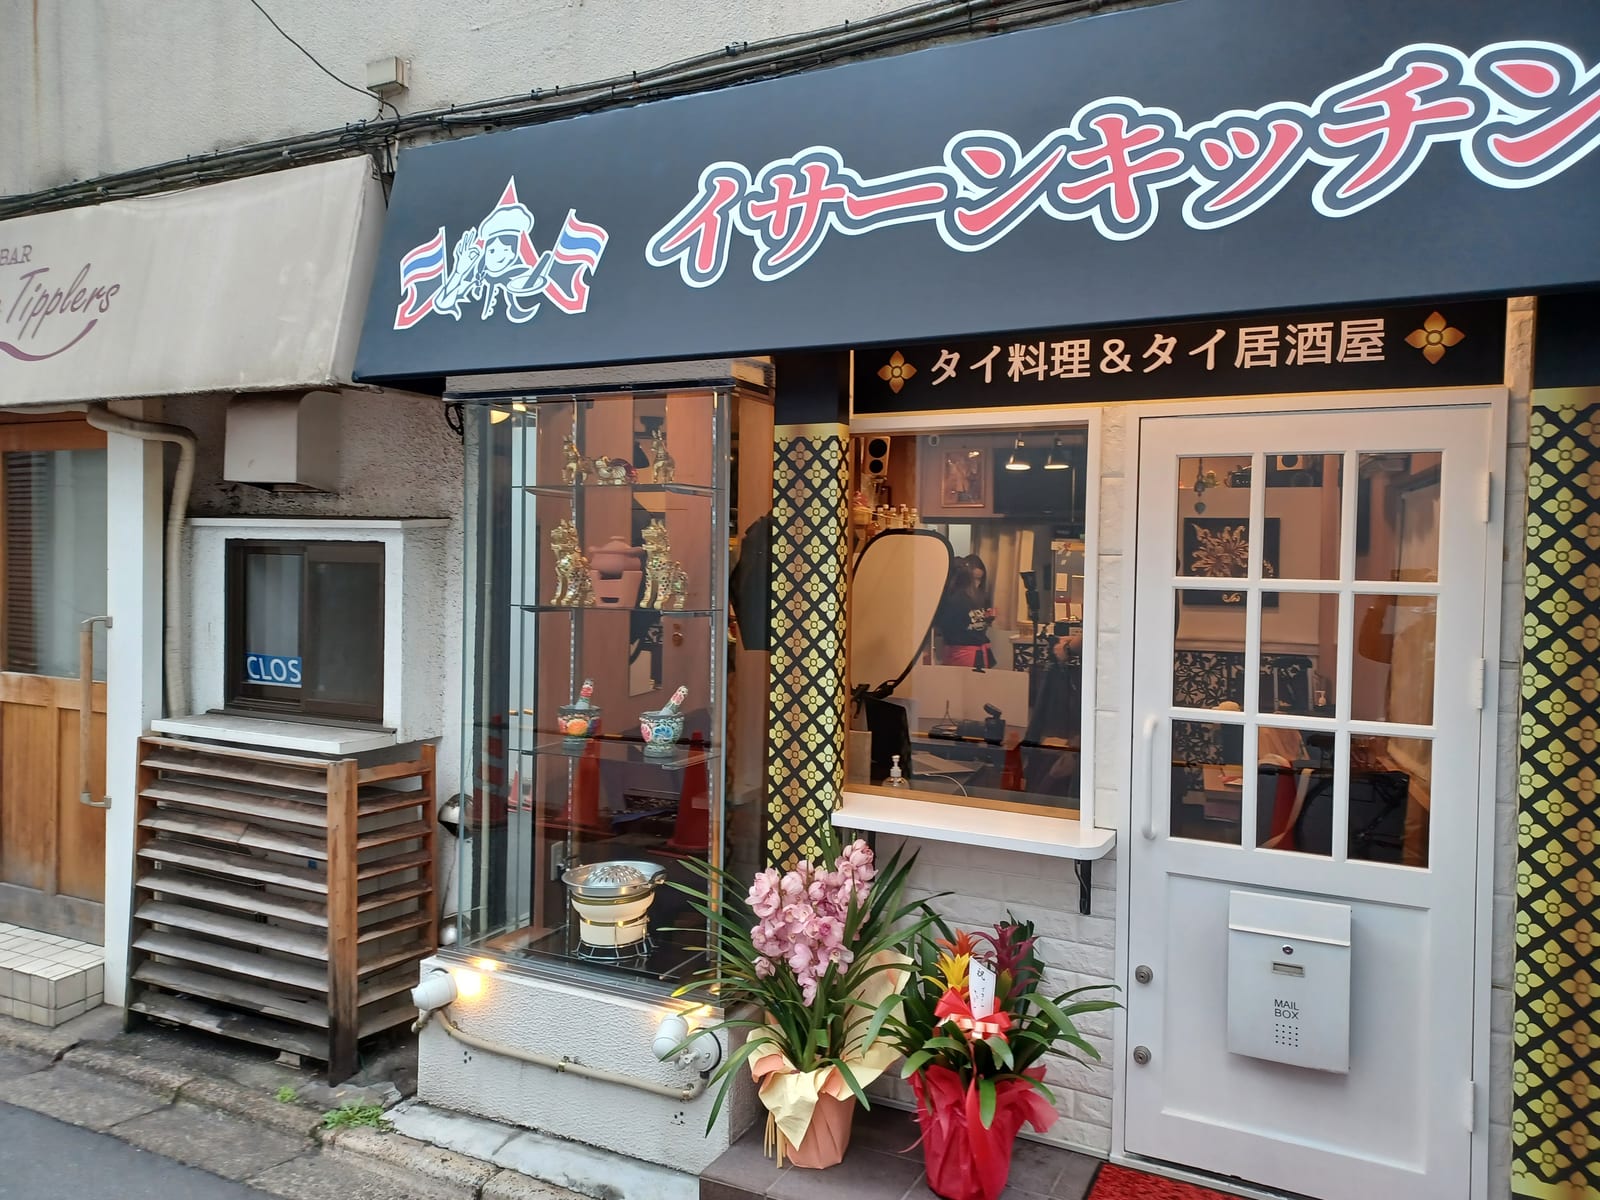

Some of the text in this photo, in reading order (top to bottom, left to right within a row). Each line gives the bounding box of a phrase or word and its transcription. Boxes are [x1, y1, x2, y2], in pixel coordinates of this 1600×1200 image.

[646, 40, 1600, 288] イサーンキッチン
[6, 263, 120, 340] Tipplers
[930, 317, 1386, 386] タイ料理&タイ居酒屋
[246, 656, 302, 683] CLOS
[1274, 999, 1299, 1011] MAIL
[1274, 1008, 1299, 1020] BOX
